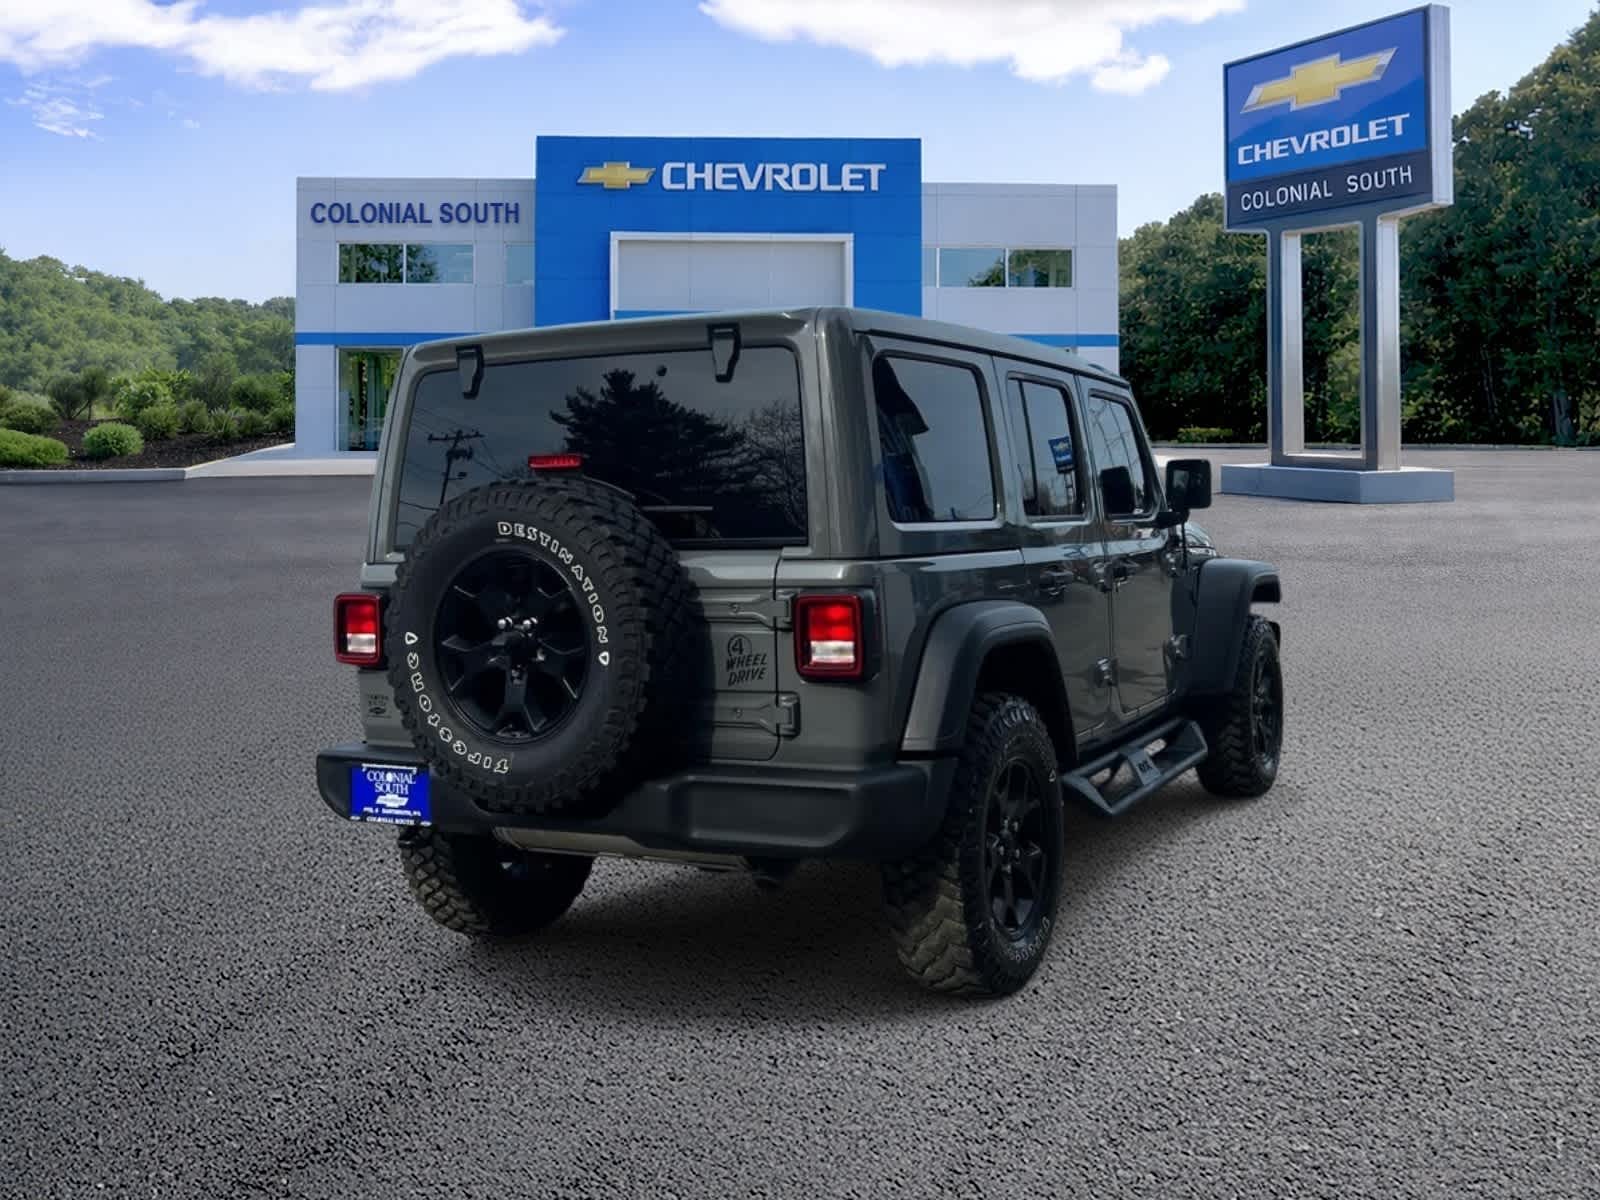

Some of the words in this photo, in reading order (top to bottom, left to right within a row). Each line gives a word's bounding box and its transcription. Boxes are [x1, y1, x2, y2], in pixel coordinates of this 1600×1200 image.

[1238, 113, 1410, 165] CHEVROLET
[661, 161, 886, 193] CHEVROLET
[1240, 179, 1333, 212] COLONIAL
[1346, 165, 1413, 194] SOUTH
[310, 202, 432, 224] COLONIAL
[439, 202, 520, 224] SOUTH
[497, 521, 609, 645] DESTINATION
[726, 653, 767, 672] WHEEL
[728, 667, 766, 687] DRIVE
[366, 771, 416, 784] COLONIAL
[374, 782, 409, 795] SOUTH
